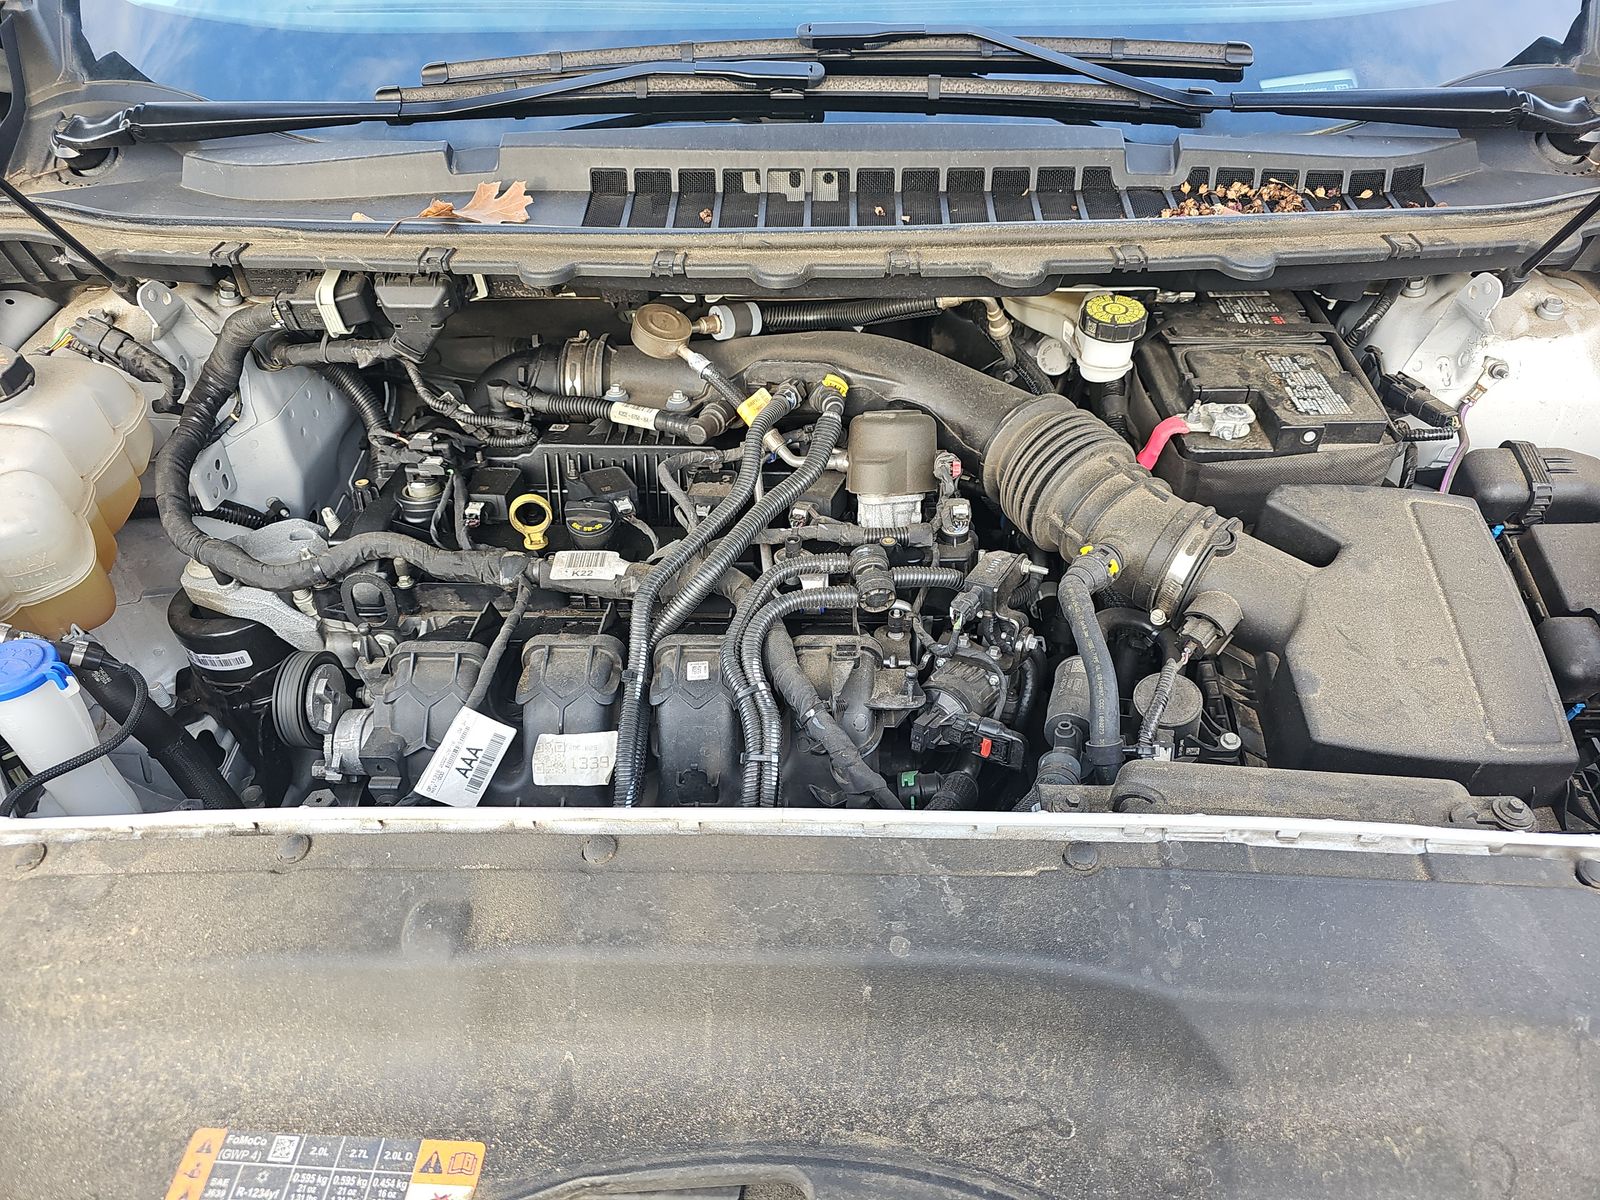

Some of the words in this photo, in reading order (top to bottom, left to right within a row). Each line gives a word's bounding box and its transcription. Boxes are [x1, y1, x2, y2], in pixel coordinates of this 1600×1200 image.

[571, 569, 594, 577] K22
[455, 747, 483, 779] AAA
[571, 756, 610, 770] 1339
[226, 1134, 268, 1146] FoMoCo
[217, 1148, 250, 1160] (GWP
[250, 1150, 263, 1162] 4)
[309, 1146, 329, 1156] 2.0L
[349, 1149, 369, 1159] 2.7L
[383, 1150, 403, 1160] 2.0L
[404, 1152, 413, 1161] D
[209, 1177, 230, 1187] SAE
[292, 1172, 316, 1184] 0.595
[316, 1174, 329, 1187] kg
[332, 1174, 357, 1186] 0.595
[356, 1174, 368, 1189] kg
[372, 1177, 396, 1188] 0.454
[396, 1178, 408, 1191] kg
[236, 1186, 281, 1200] R-1234yf
[297, 1183, 307, 1193] 21
[307, 1186, 317, 1194] oz
[337, 1186, 347, 1195] 21
[378, 1189, 388, 1198] 16
[387, 1191, 397, 1199] oz
